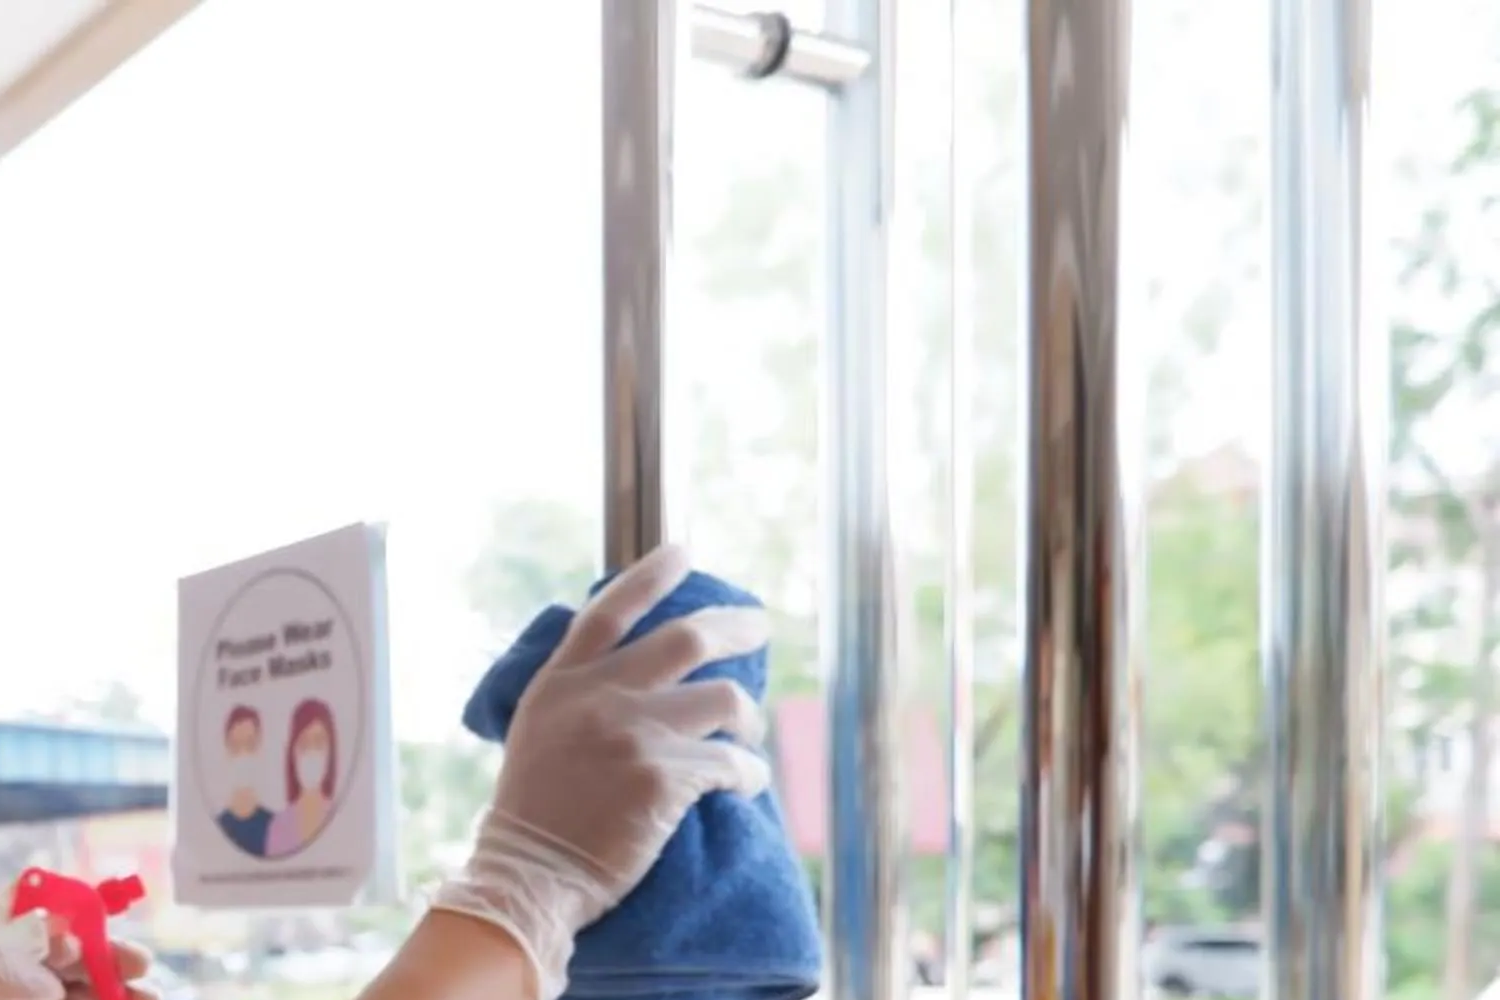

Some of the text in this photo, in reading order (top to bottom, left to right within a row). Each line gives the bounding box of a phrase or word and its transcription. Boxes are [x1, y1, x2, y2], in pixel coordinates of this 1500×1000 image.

[217, 620, 334, 659] Please Wear
[218, 650, 332, 690] Face Masks
